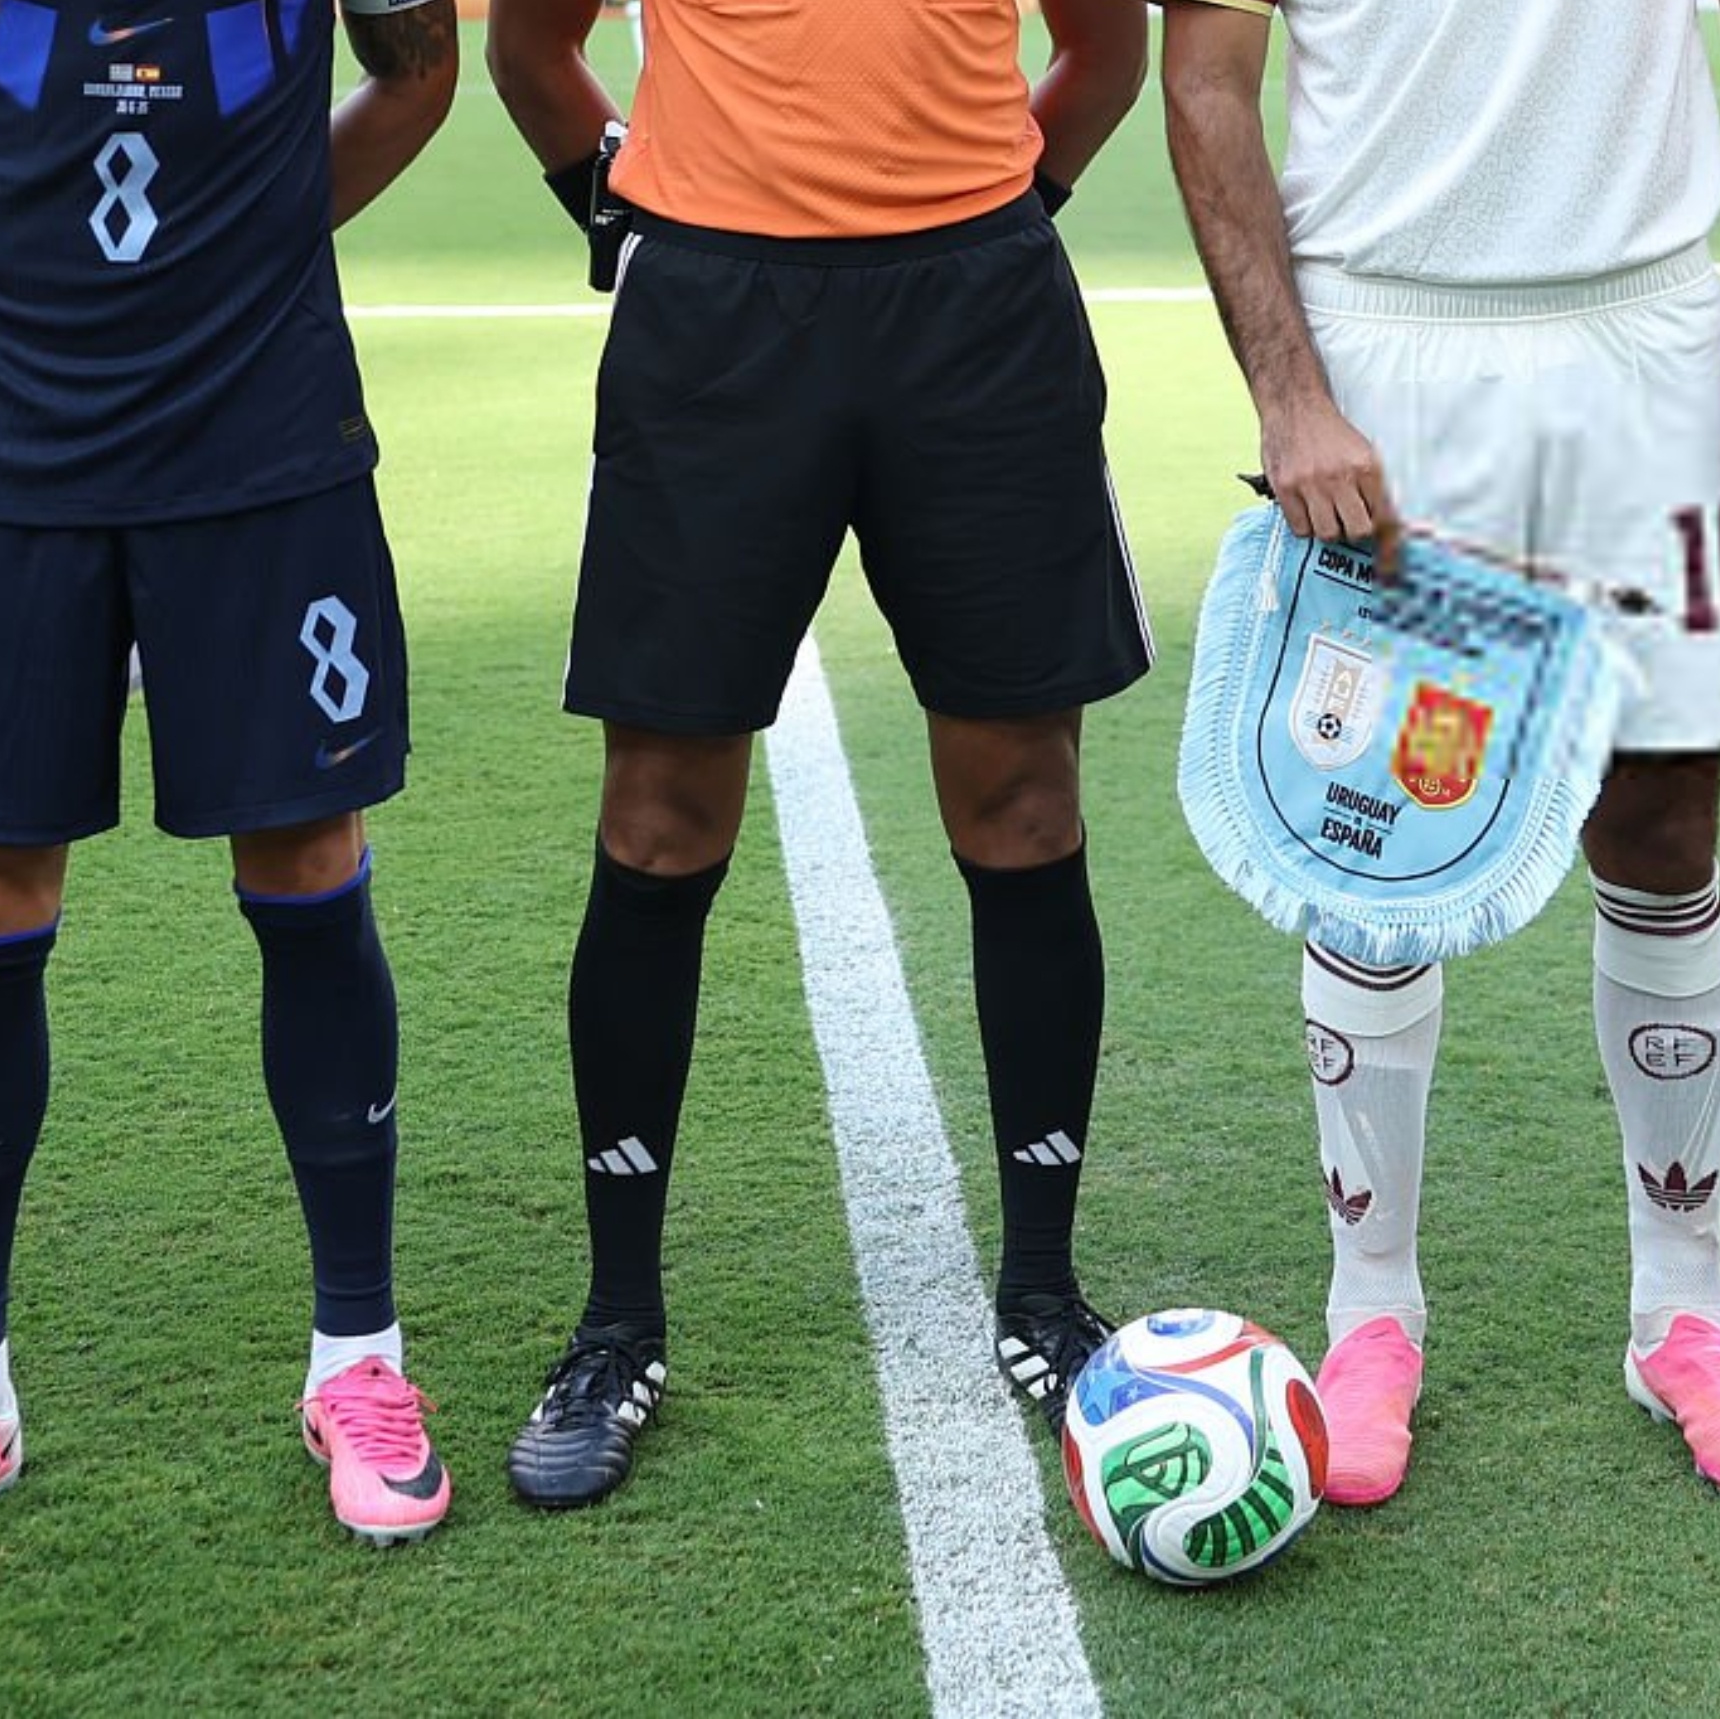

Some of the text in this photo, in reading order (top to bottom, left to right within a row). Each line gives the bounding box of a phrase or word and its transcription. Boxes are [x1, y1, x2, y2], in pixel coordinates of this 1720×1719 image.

[88, 132, 160, 262] 8
[1317, 547, 1357, 579] COPA
[300, 595, 370, 723] 8
[1326, 781, 1402, 826] URUGUAY
[1321, 816, 1383, 860] ESPAÑA
